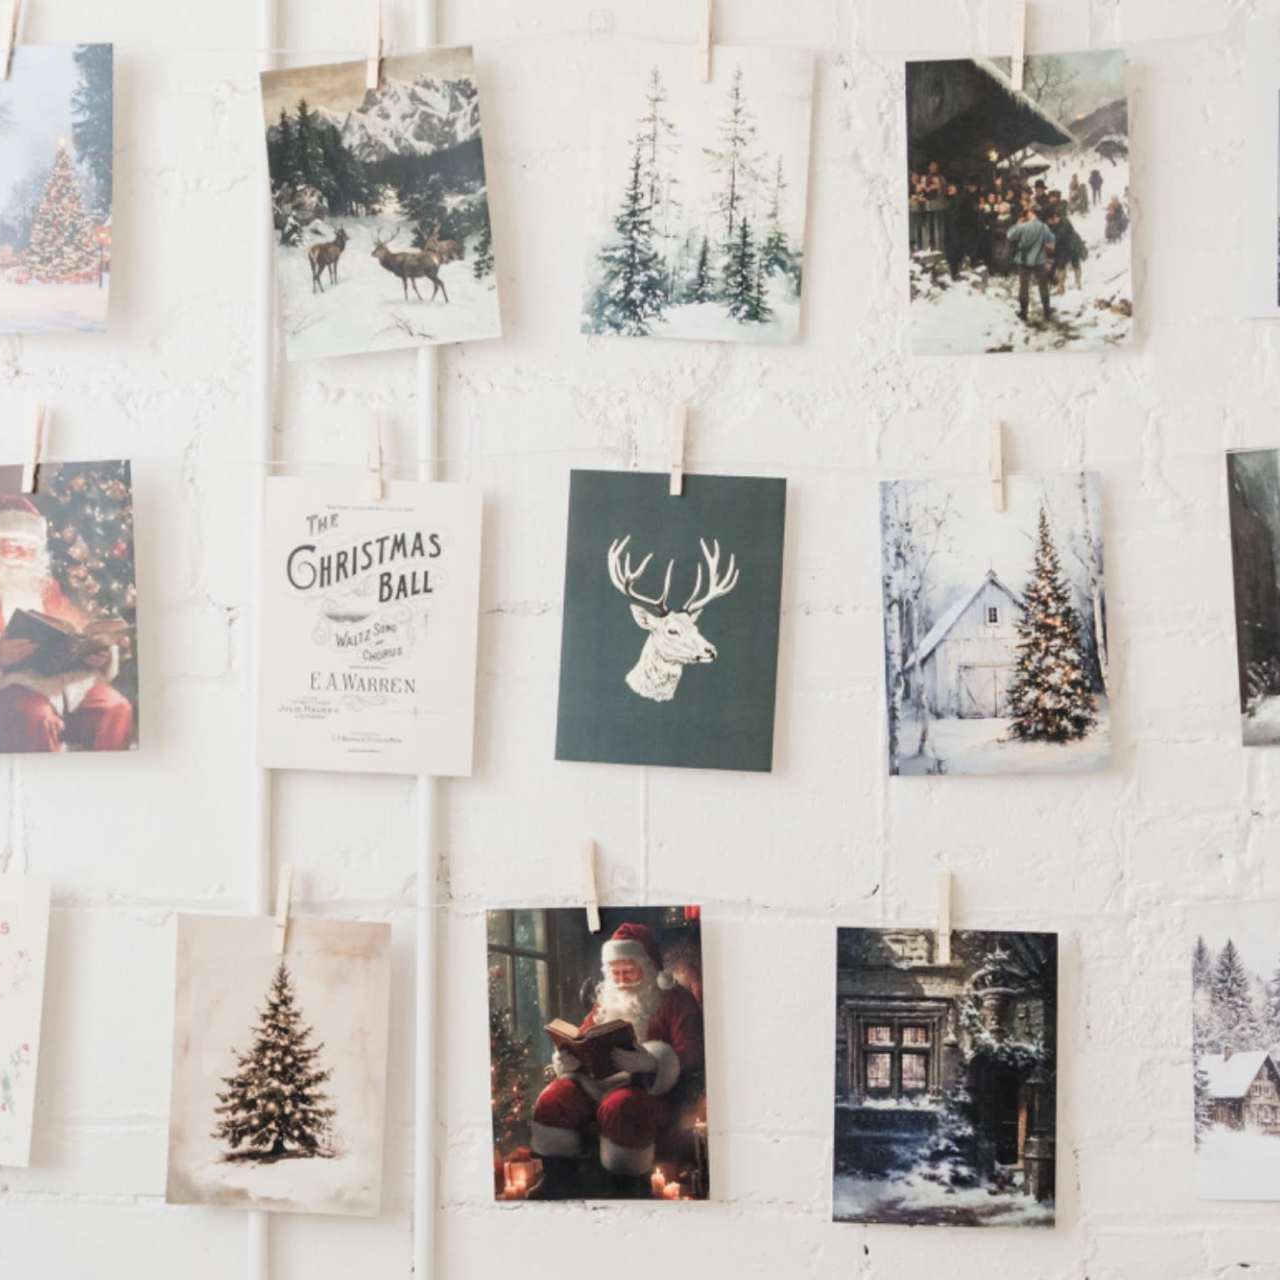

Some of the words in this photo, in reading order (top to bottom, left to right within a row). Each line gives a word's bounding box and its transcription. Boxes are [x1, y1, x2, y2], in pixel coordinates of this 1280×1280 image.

[306, 513, 340, 536] THE
[286, 531, 442, 590] CHRISTMAS
[378, 570, 434, 603] BALL
